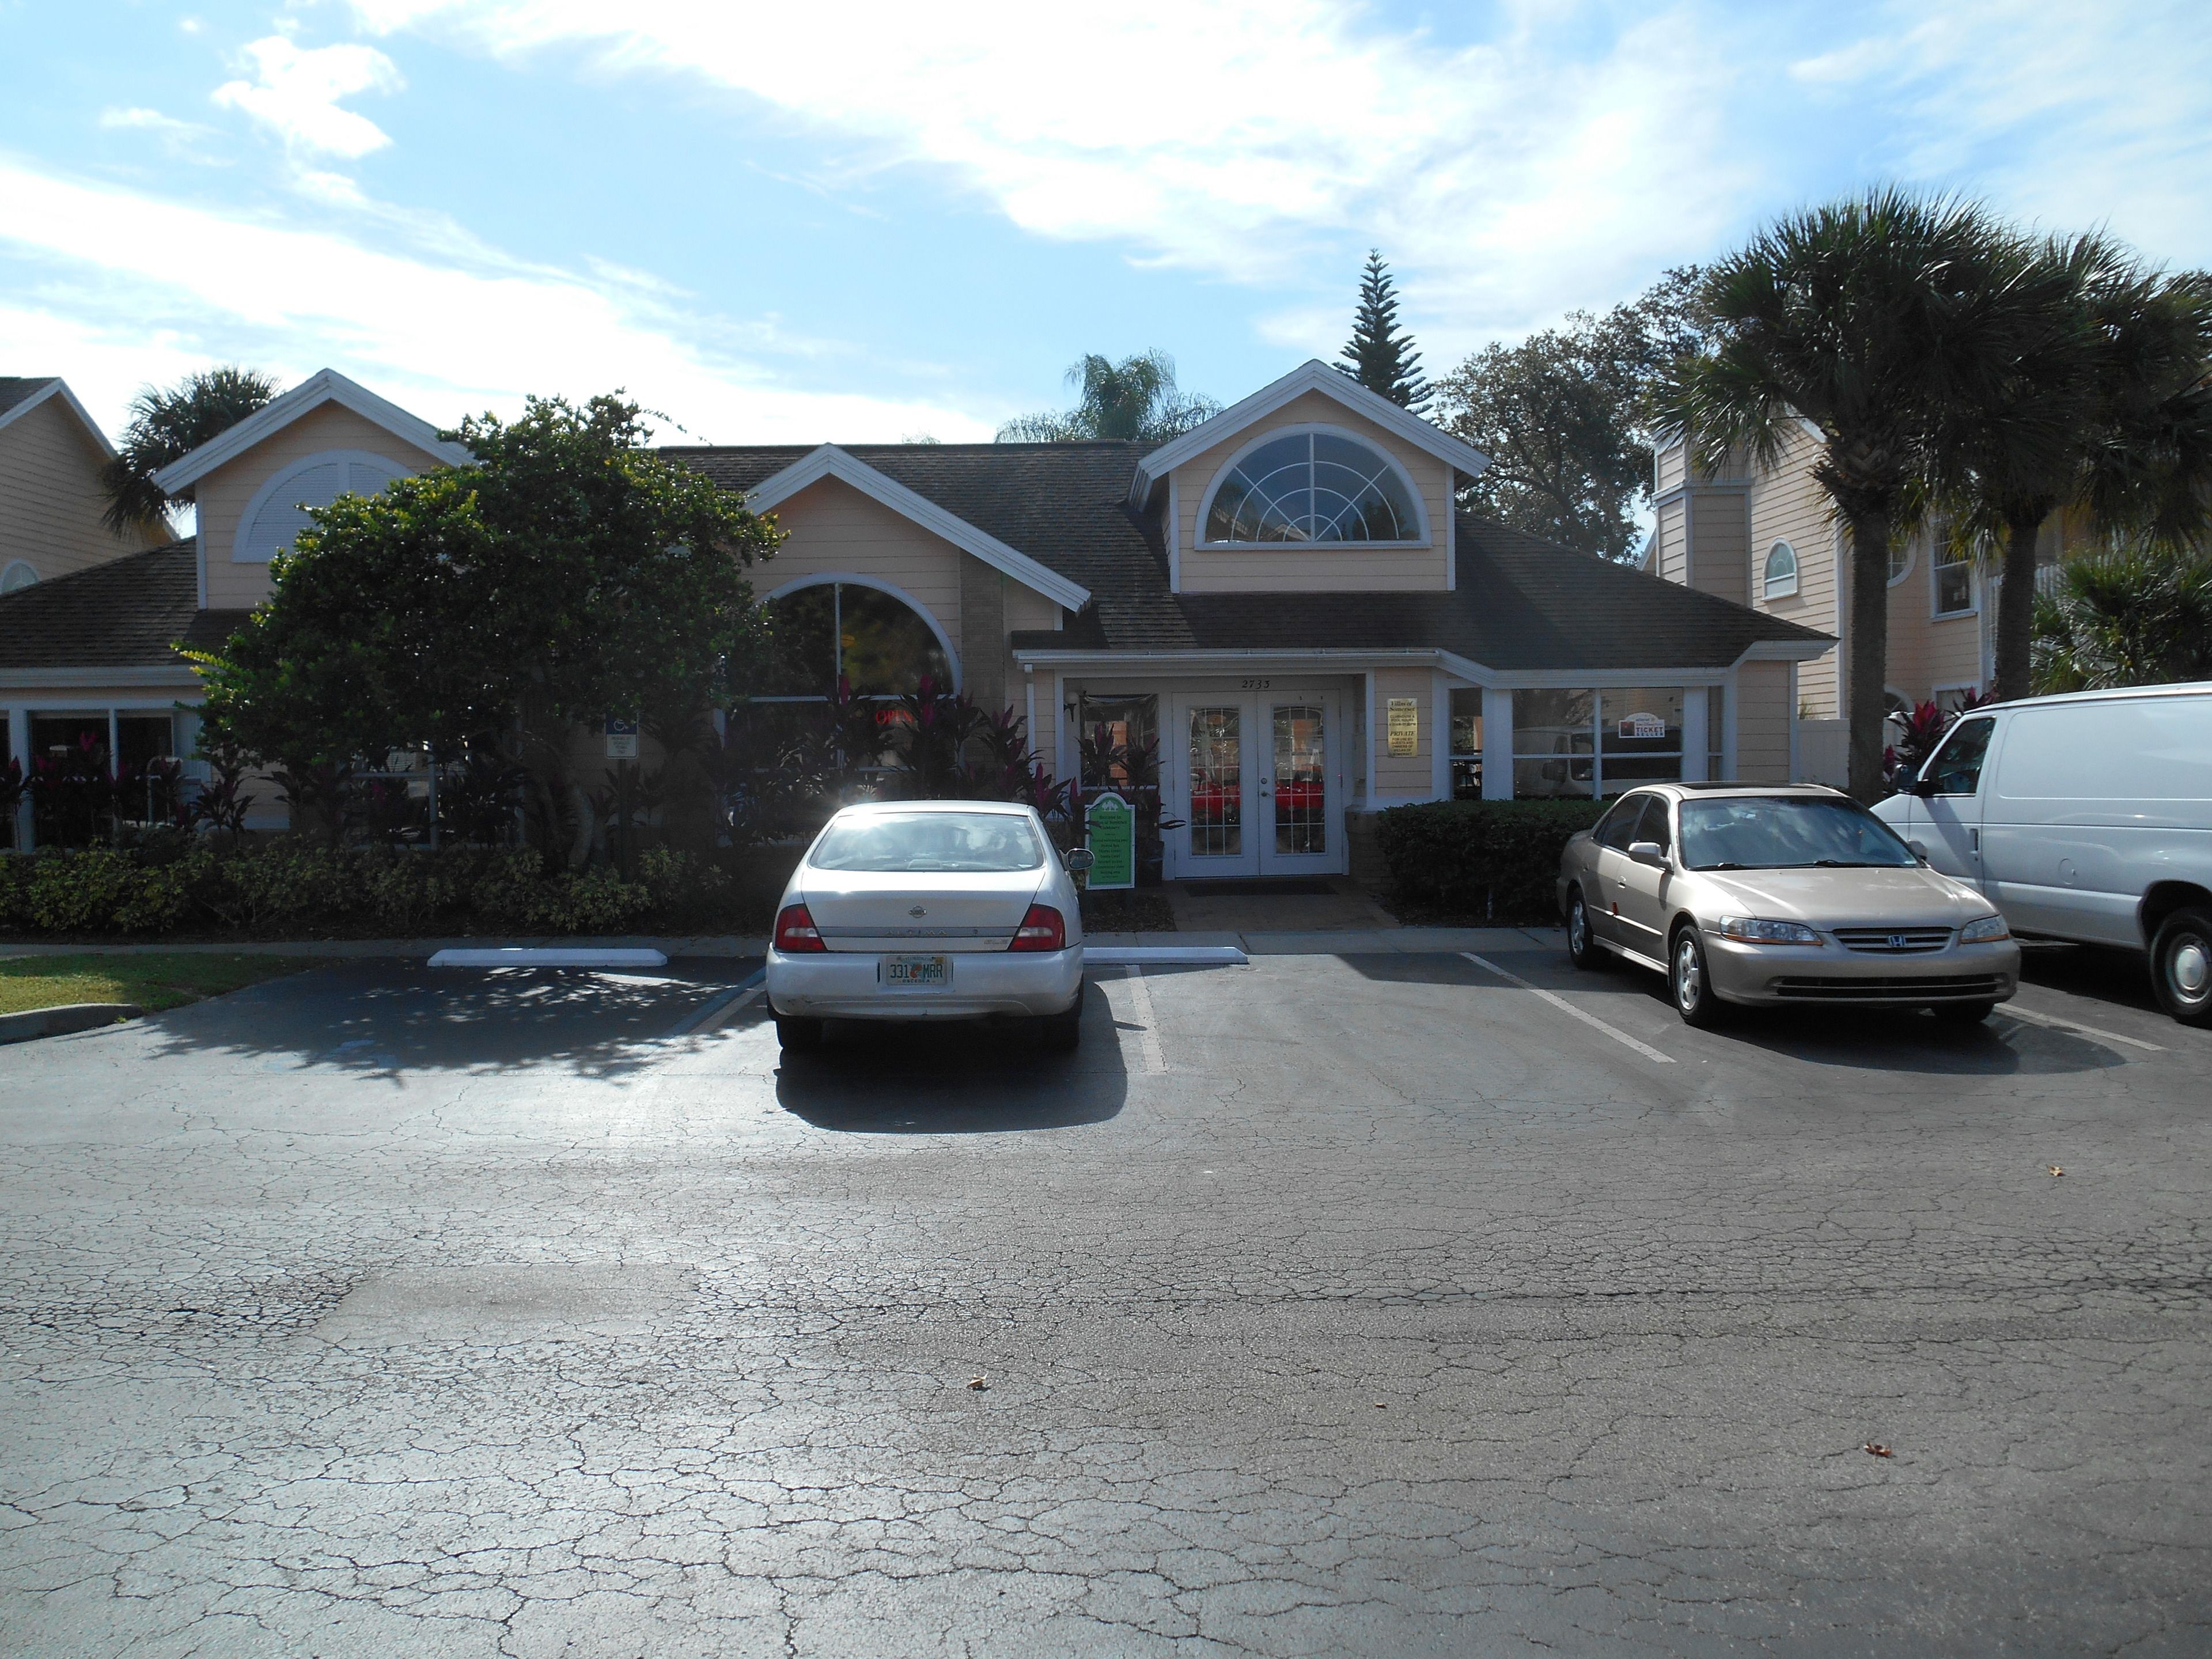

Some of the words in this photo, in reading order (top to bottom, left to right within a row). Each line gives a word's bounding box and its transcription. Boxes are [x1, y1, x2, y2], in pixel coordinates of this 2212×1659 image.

[1241, 680, 1270, 689] 2733
[875, 710, 913, 725] OPEN
[890, 964, 910, 978] 331
[923, 964, 942, 978] MRR
